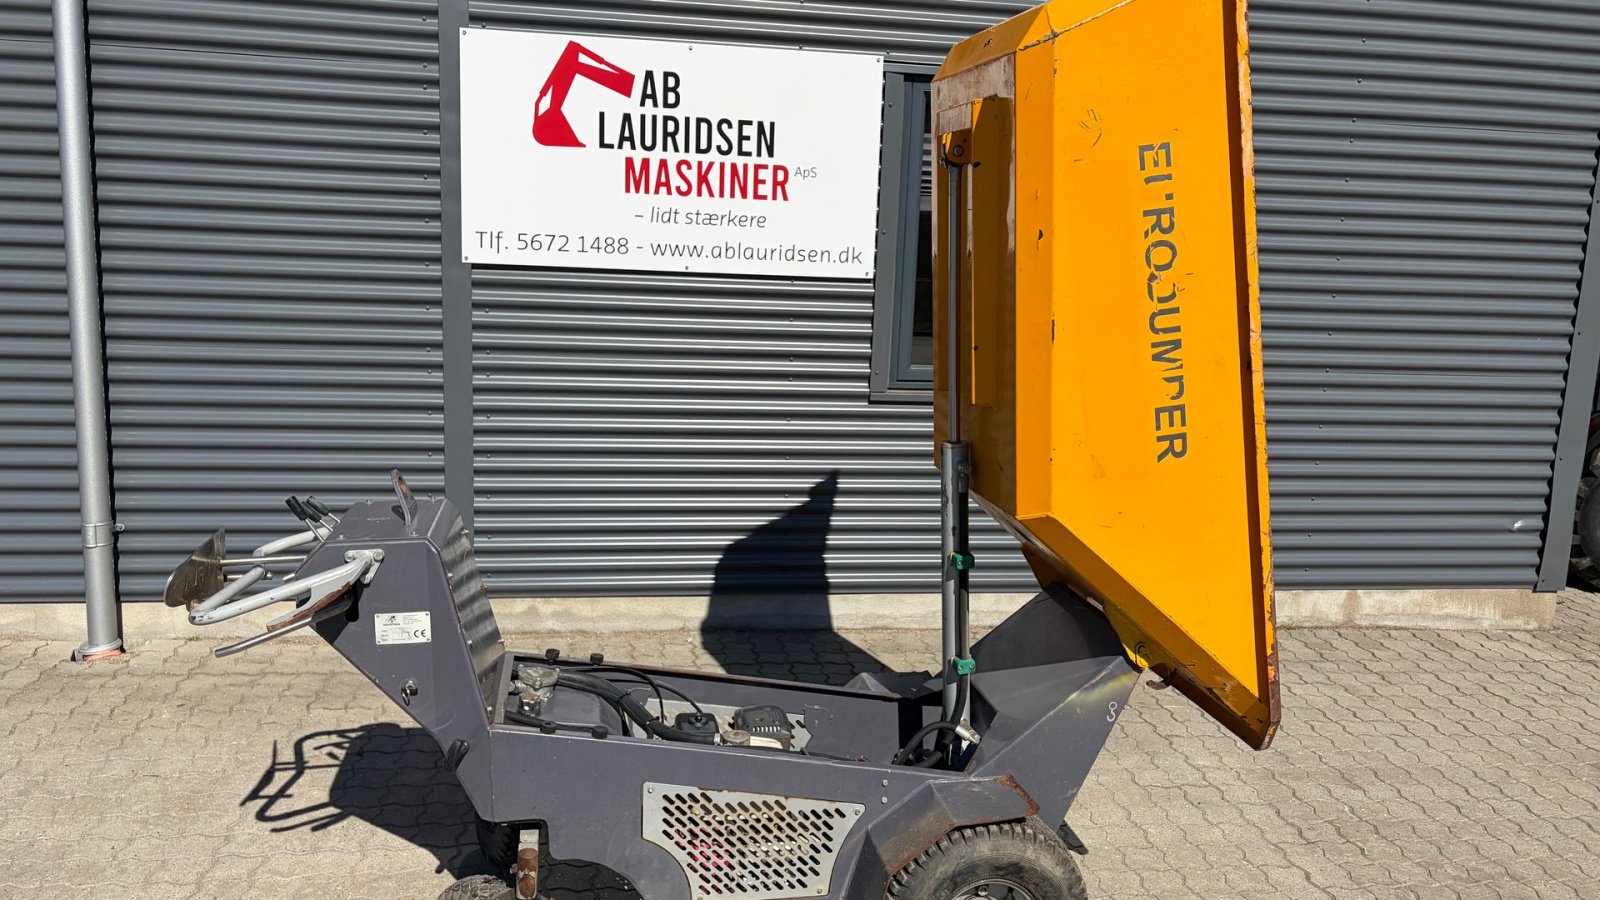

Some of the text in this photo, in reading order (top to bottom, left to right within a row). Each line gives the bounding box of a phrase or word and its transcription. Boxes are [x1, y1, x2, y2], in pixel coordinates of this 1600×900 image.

[639, 70, 681, 109] AB
[598, 110, 776, 158] LAURIDSEN
[624, 156, 817, 202] MASKINER ApS
[650, 206, 680, 225] lidt
[684, 209, 767, 229] stærkere
[475, 231, 509, 251] Tlf.
[517, 232, 570, 253] 5672
[577, 235, 629, 255] 1488
[650, 241, 862, 264] www.ablauridsen.dk
[413, 628, 426, 639] CE
